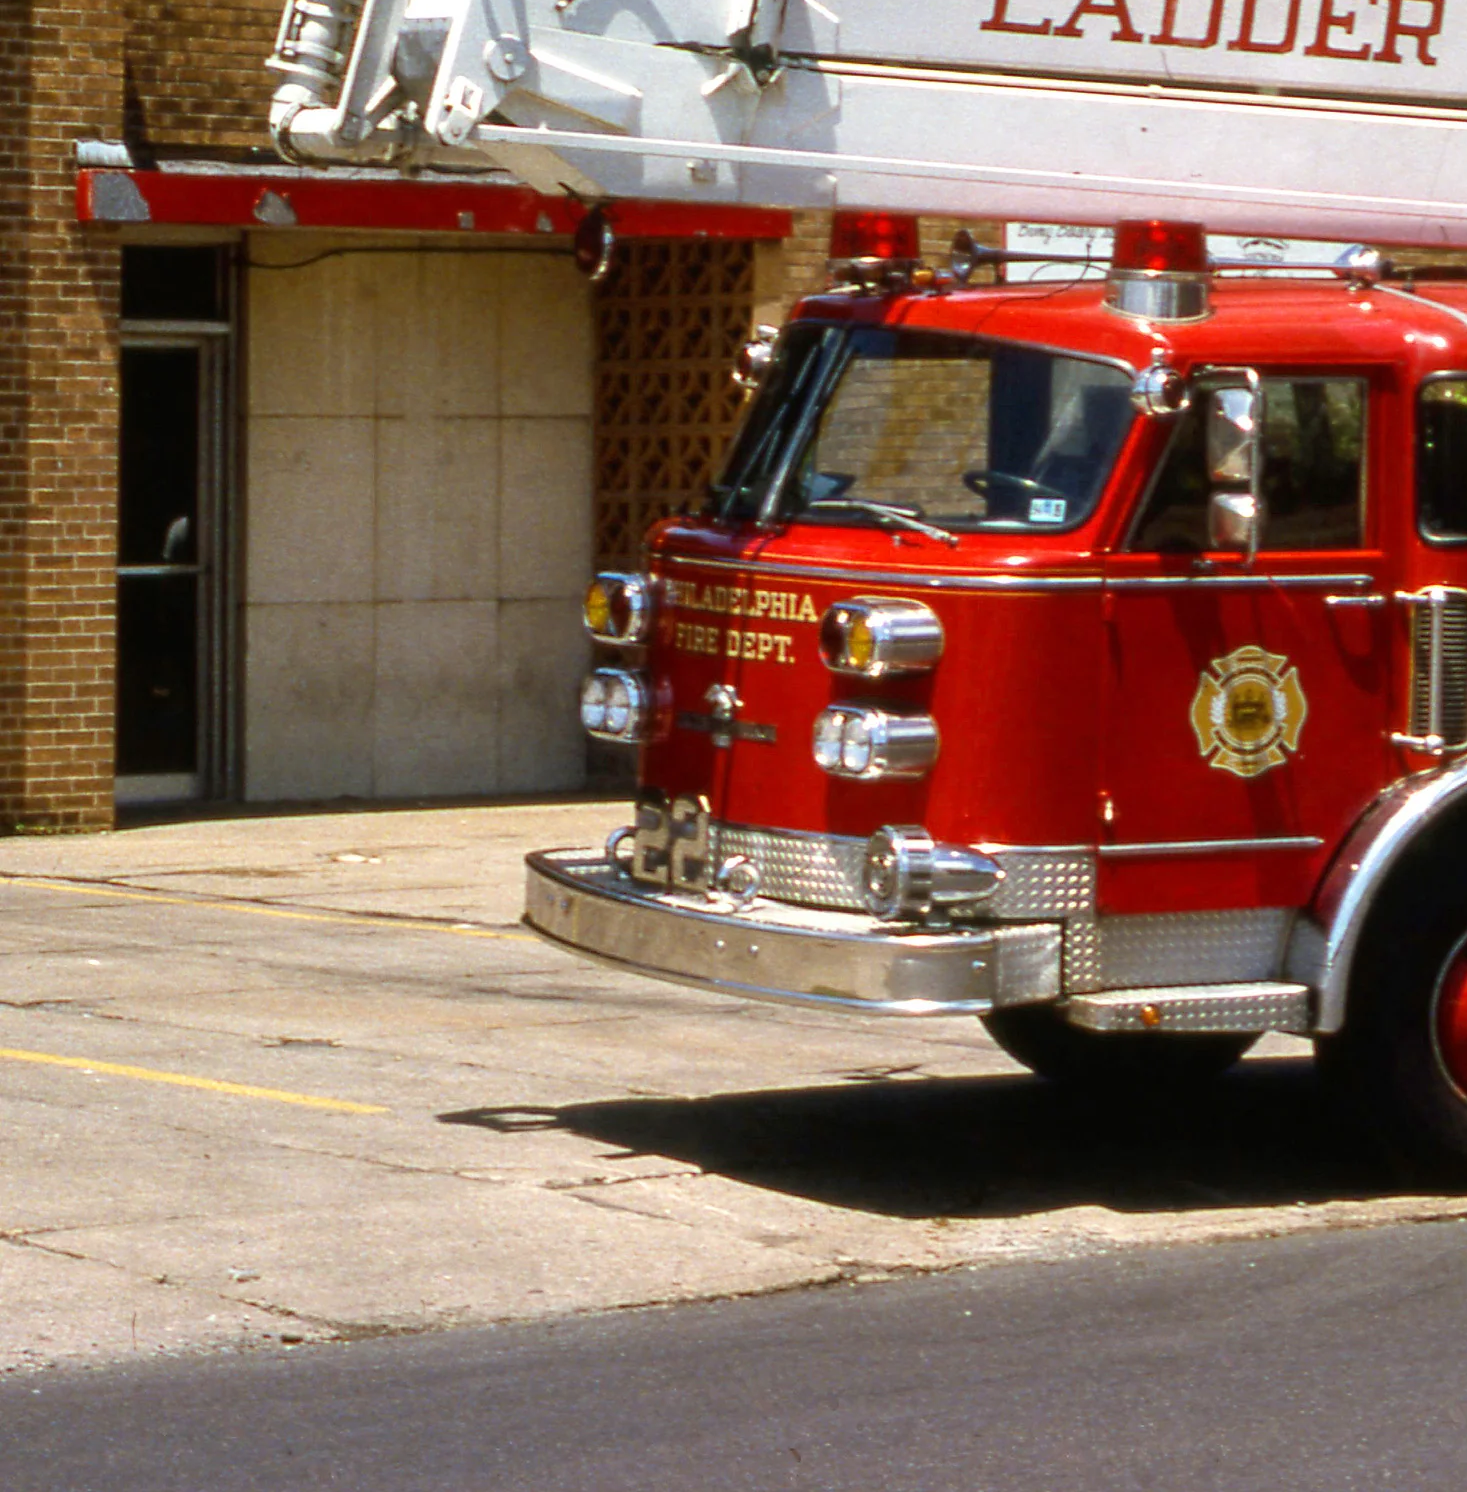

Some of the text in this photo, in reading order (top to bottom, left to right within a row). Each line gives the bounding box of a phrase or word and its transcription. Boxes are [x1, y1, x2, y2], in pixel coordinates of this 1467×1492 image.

[664, 577, 818, 623] PHILADELPHIA
[674, 621, 796, 664] FIRE DEPT.
